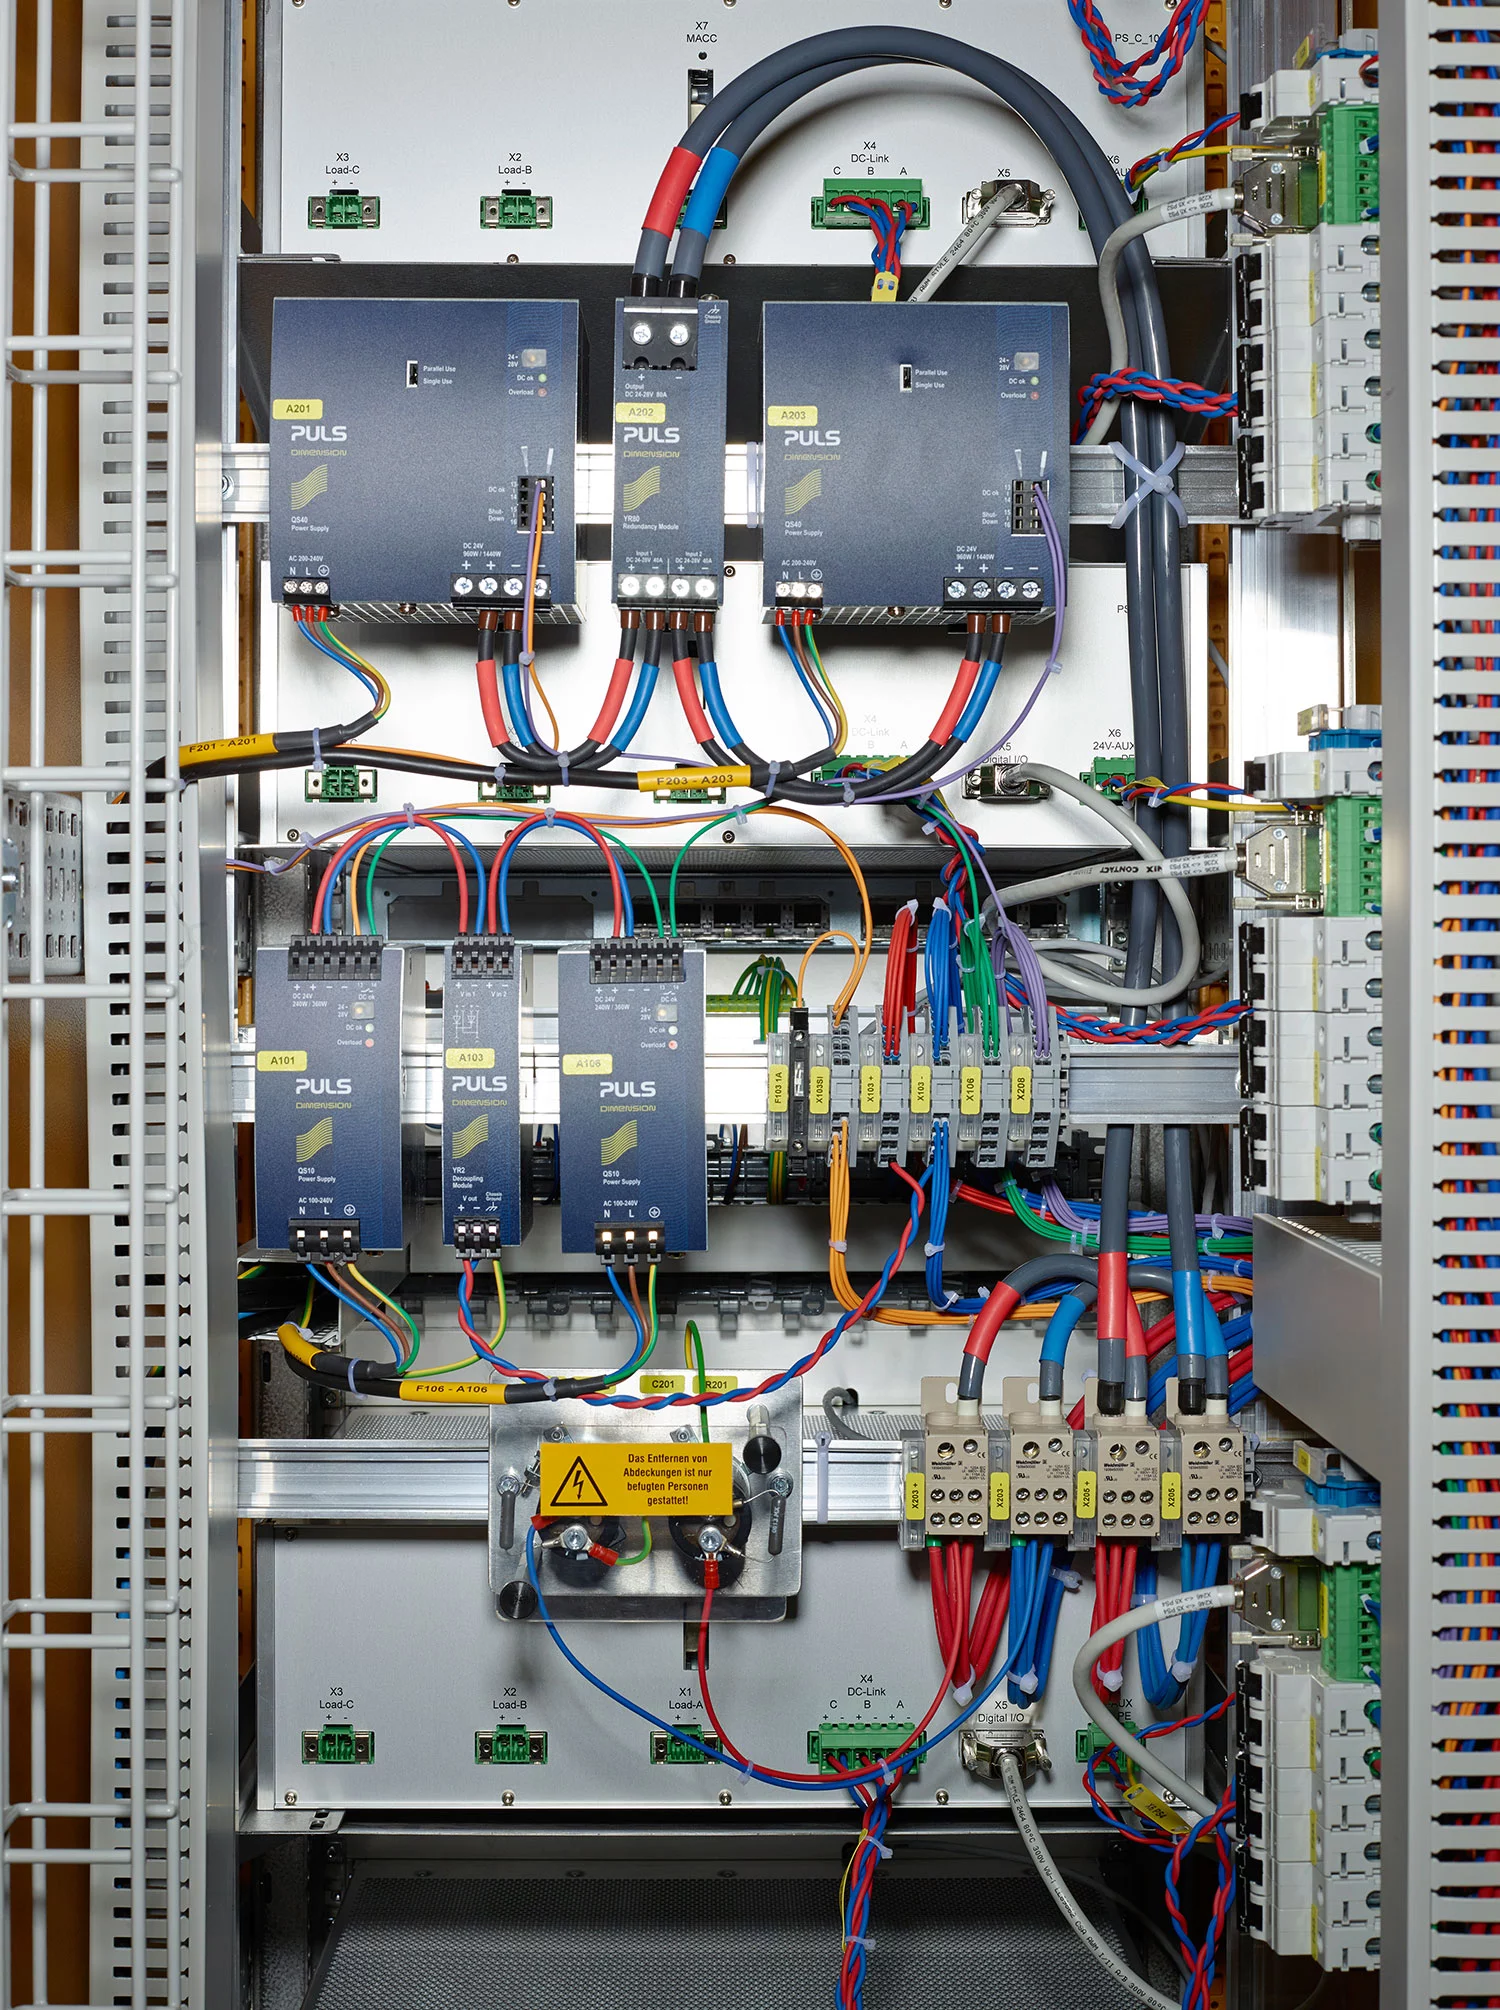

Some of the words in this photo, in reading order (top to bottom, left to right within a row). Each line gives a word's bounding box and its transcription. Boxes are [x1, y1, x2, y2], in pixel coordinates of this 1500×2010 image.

[696, 22, 708, 30] X7
[686, 34, 718, 43] MACC
[863, 141, 876, 150] X4
[336, 153, 350, 162] X3
[508, 153, 522, 162] X2
[850, 154, 890, 163] DC-Link
[1107, 155, 1120, 164] X6
[325, 166, 360, 175] Load-C
[498, 166, 532, 175] Load-B
[833, 166, 841, 176] C
[867, 166, 875, 176] B
[900, 166, 908, 176] A
[997, 168, 1011, 177] X5
[931, 256, 950, 277] STYLE
[950, 238, 965, 256] 2464
[624, 382, 644, 391] Output
[286, 404, 311, 414] A201
[628, 408, 654, 417] A202
[781, 410, 806, 420] A203
[291, 426, 347, 442] PULS
[624, 427, 680, 443] PULS
[784, 430, 841, 446] PULS
[291, 516, 308, 524] QS40
[310, 525, 329, 533] Supply
[622, 523, 657, 531] Redundancy
[784, 521, 802, 529] QS40
[804, 529, 823, 538] Supply
[289, 567, 296, 575] N
[306, 567, 311, 575] L
[782, 571, 789, 580] N
[798, 571, 804, 580] L
[1108, 728, 1122, 738] X6
[189, 743, 216, 752] F201
[228, 738, 256, 747] A201
[1093, 742, 1134, 750] 24V-AUX
[656, 776, 684, 787] F203
[700, 774, 734, 785] A203
[270, 1056, 295, 1065] A101
[459, 1053, 484, 1062] A103
[576, 1059, 602, 1068] A106
[774, 1071, 782, 1082] 1A
[295, 1079, 352, 1095] PULS
[452, 1075, 508, 1092] PULS
[600, 1082, 656, 1098] PULS
[966, 1077, 974, 1102] X106
[1016, 1077, 1025, 1100] X208
[452, 1175, 484, 1183] Decoupling
[299, 1207, 306, 1215] N
[324, 1207, 330, 1215] L
[604, 1210, 610, 1218] N
[629, 1210, 634, 1218] L
[416, 1384, 444, 1393] F106
[456, 1384, 489, 1394] A106
[652, 1380, 675, 1389] C201
[705, 1380, 728, 1389] R201
[628, 1454, 646, 1463] Das
[648, 1454, 689, 1463] Entfernen
[623, 1468, 682, 1478] Abdeckungen
[684, 1468, 696, 1477] ist
[627, 1482, 665, 1493] befugten
[668, 1482, 709, 1491] Personen
[647, 1496, 689, 1506] gestattet!
[860, 1674, 874, 1684] X4
[330, 1687, 343, 1696] X3
[503, 1687, 517, 1696] X2
[679, 1687, 692, 1696] X1
[847, 1687, 886, 1696] DC-Link
[319, 1700, 354, 1709] Load-C
[493, 1700, 527, 1709] Load-B
[669, 1700, 704, 1709] Load-A
[829, 1700, 838, 1709] C
[864, 1700, 871, 1709] B
[896, 1700, 905, 1709] A
[994, 1701, 1008, 1710] X5
[978, 1713, 1008, 1725] Digital
[1010, 1713, 1024, 1722] I/O
[1118, 1712, 1132, 1720] PE
[1016, 1806, 1027, 1822] 2464
[1032, 1846, 1046, 1864] 300V
[1075, 1920, 1087, 1936] CSA
[1086, 1936, 1100, 1952] AWM
[1114, 1968, 1129, 1983] A/B
[1128, 1980, 1147, 1998] 300V
